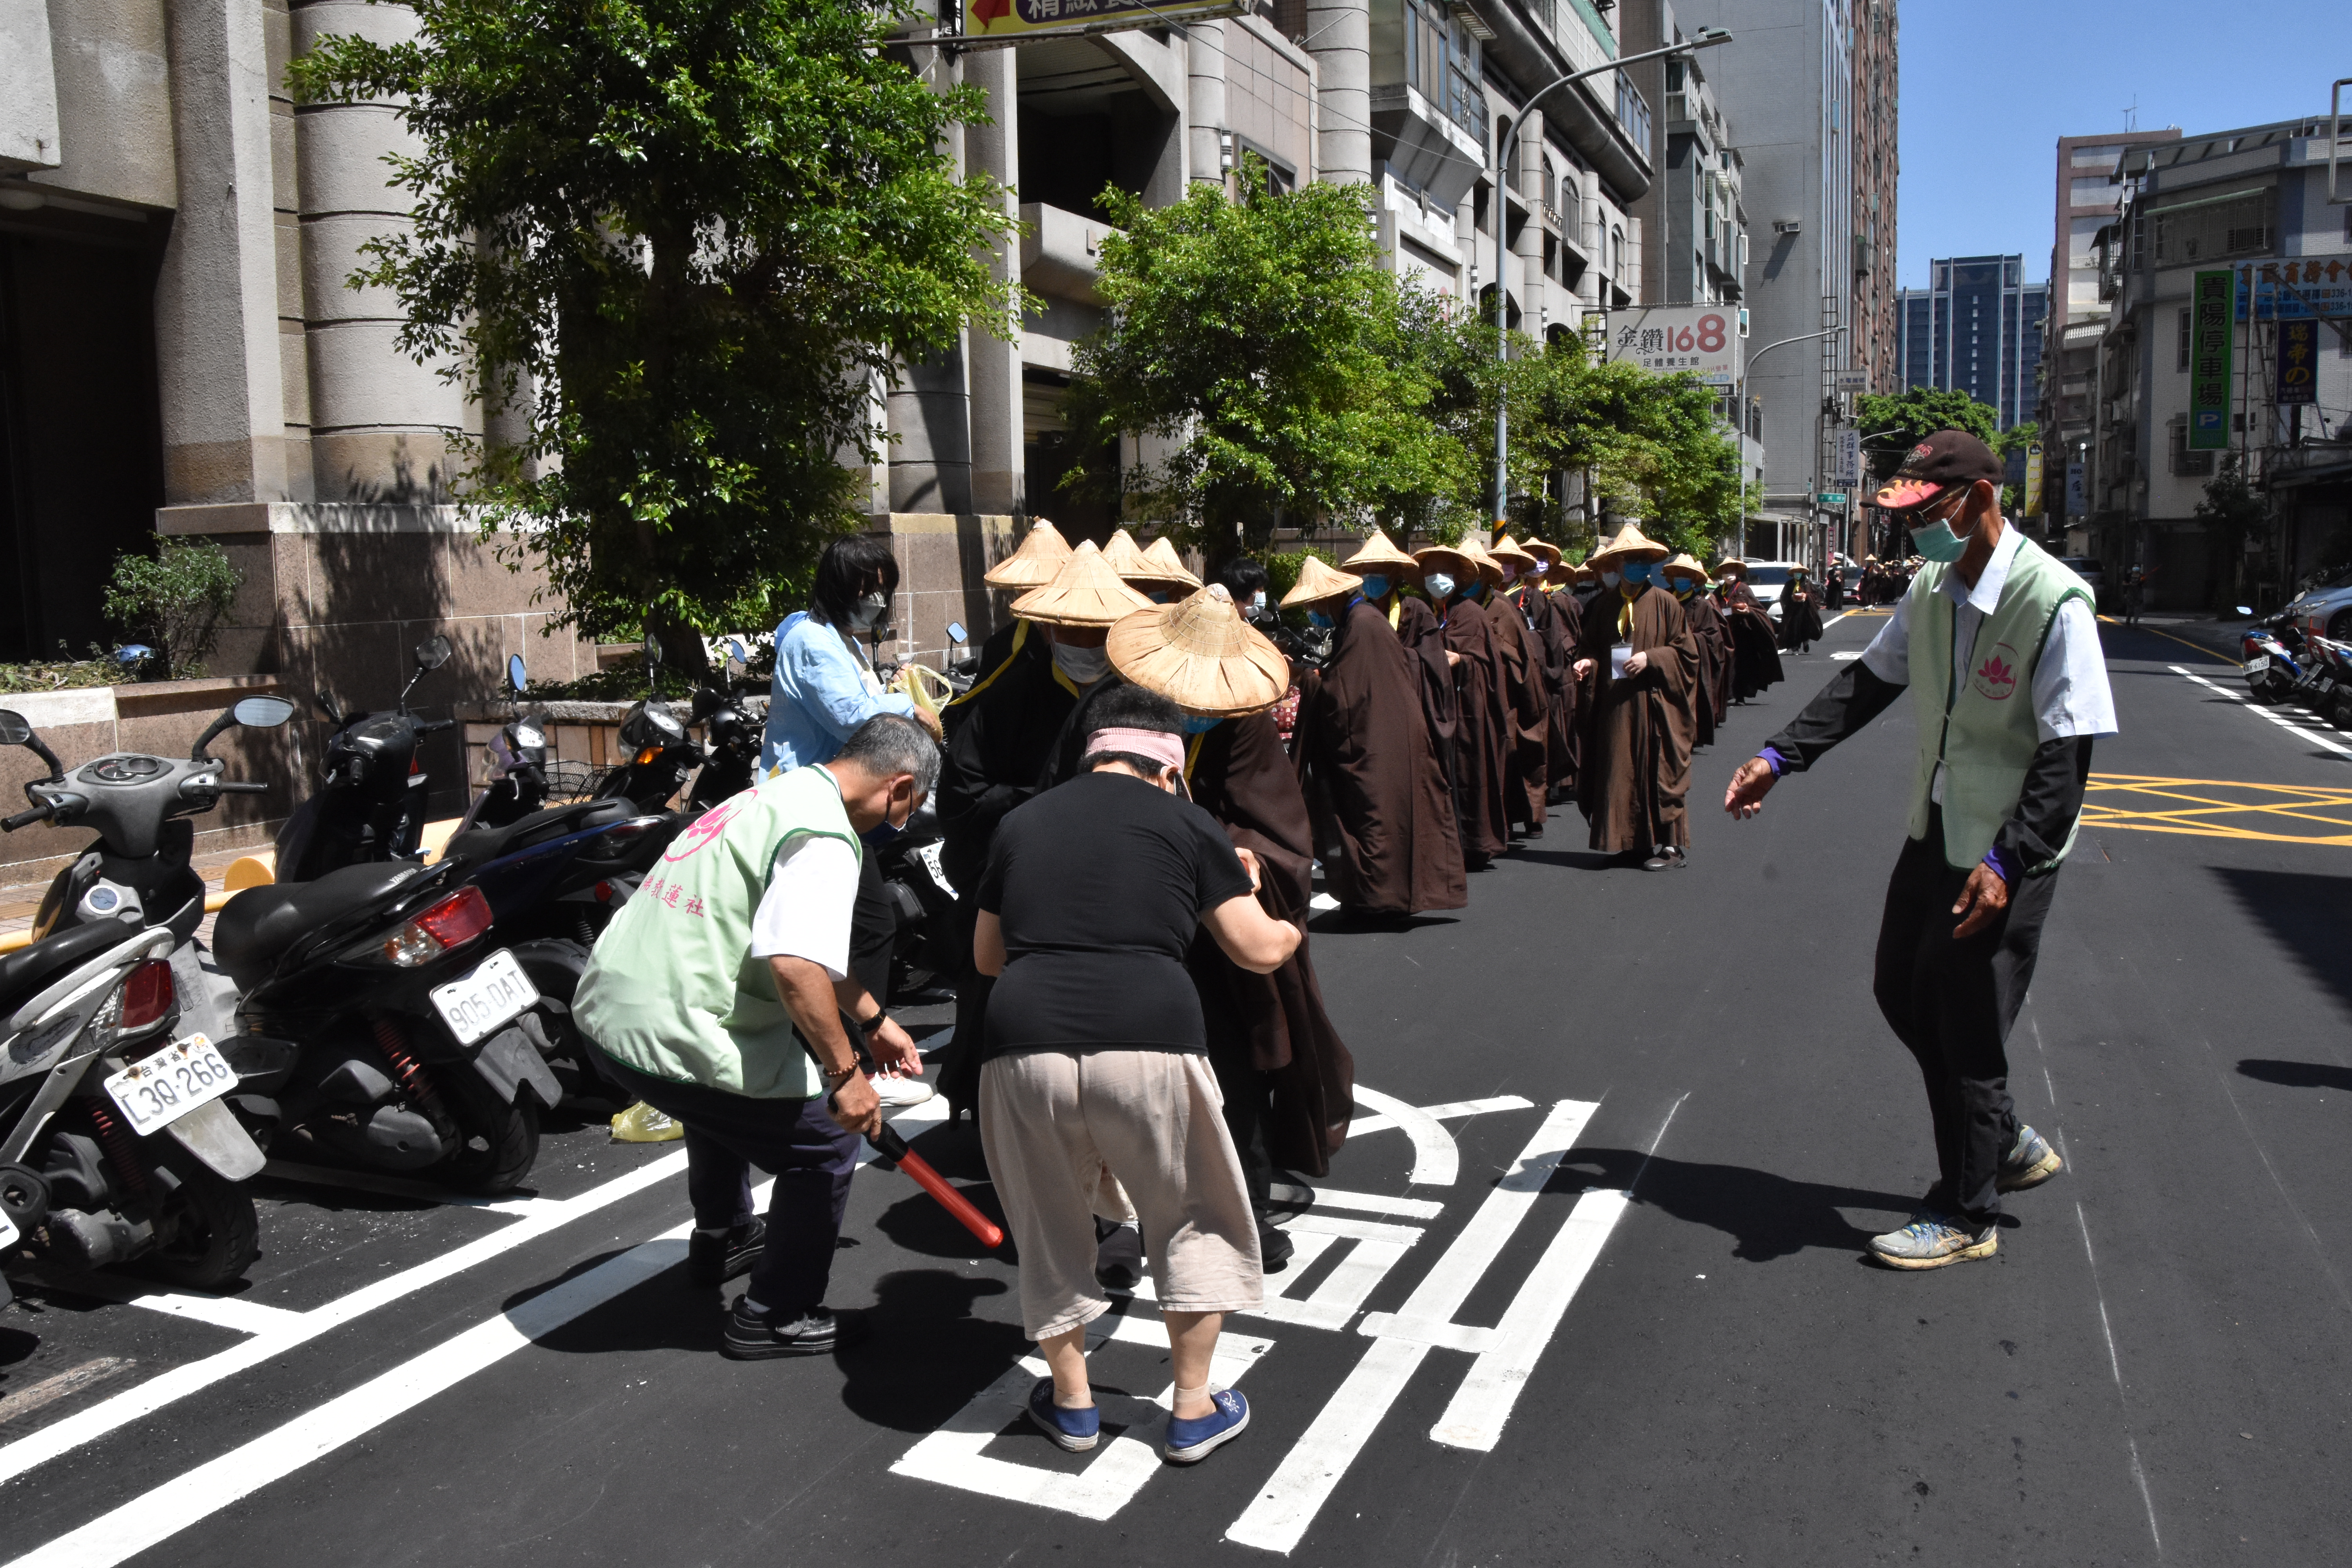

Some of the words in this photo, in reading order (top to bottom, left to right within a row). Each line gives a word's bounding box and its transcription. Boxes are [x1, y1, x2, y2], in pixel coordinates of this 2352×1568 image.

[2197, 276, 2227, 406] 貴陽停車場
[1642, 356, 1699, 367] 足體養生館
[2200, 414, 2219, 426] P
[1845, 432, 1855, 478] 益群事務所
[388, 867, 418, 884] YAMAHA
[139, 1051, 182, 1079] 台灣省
